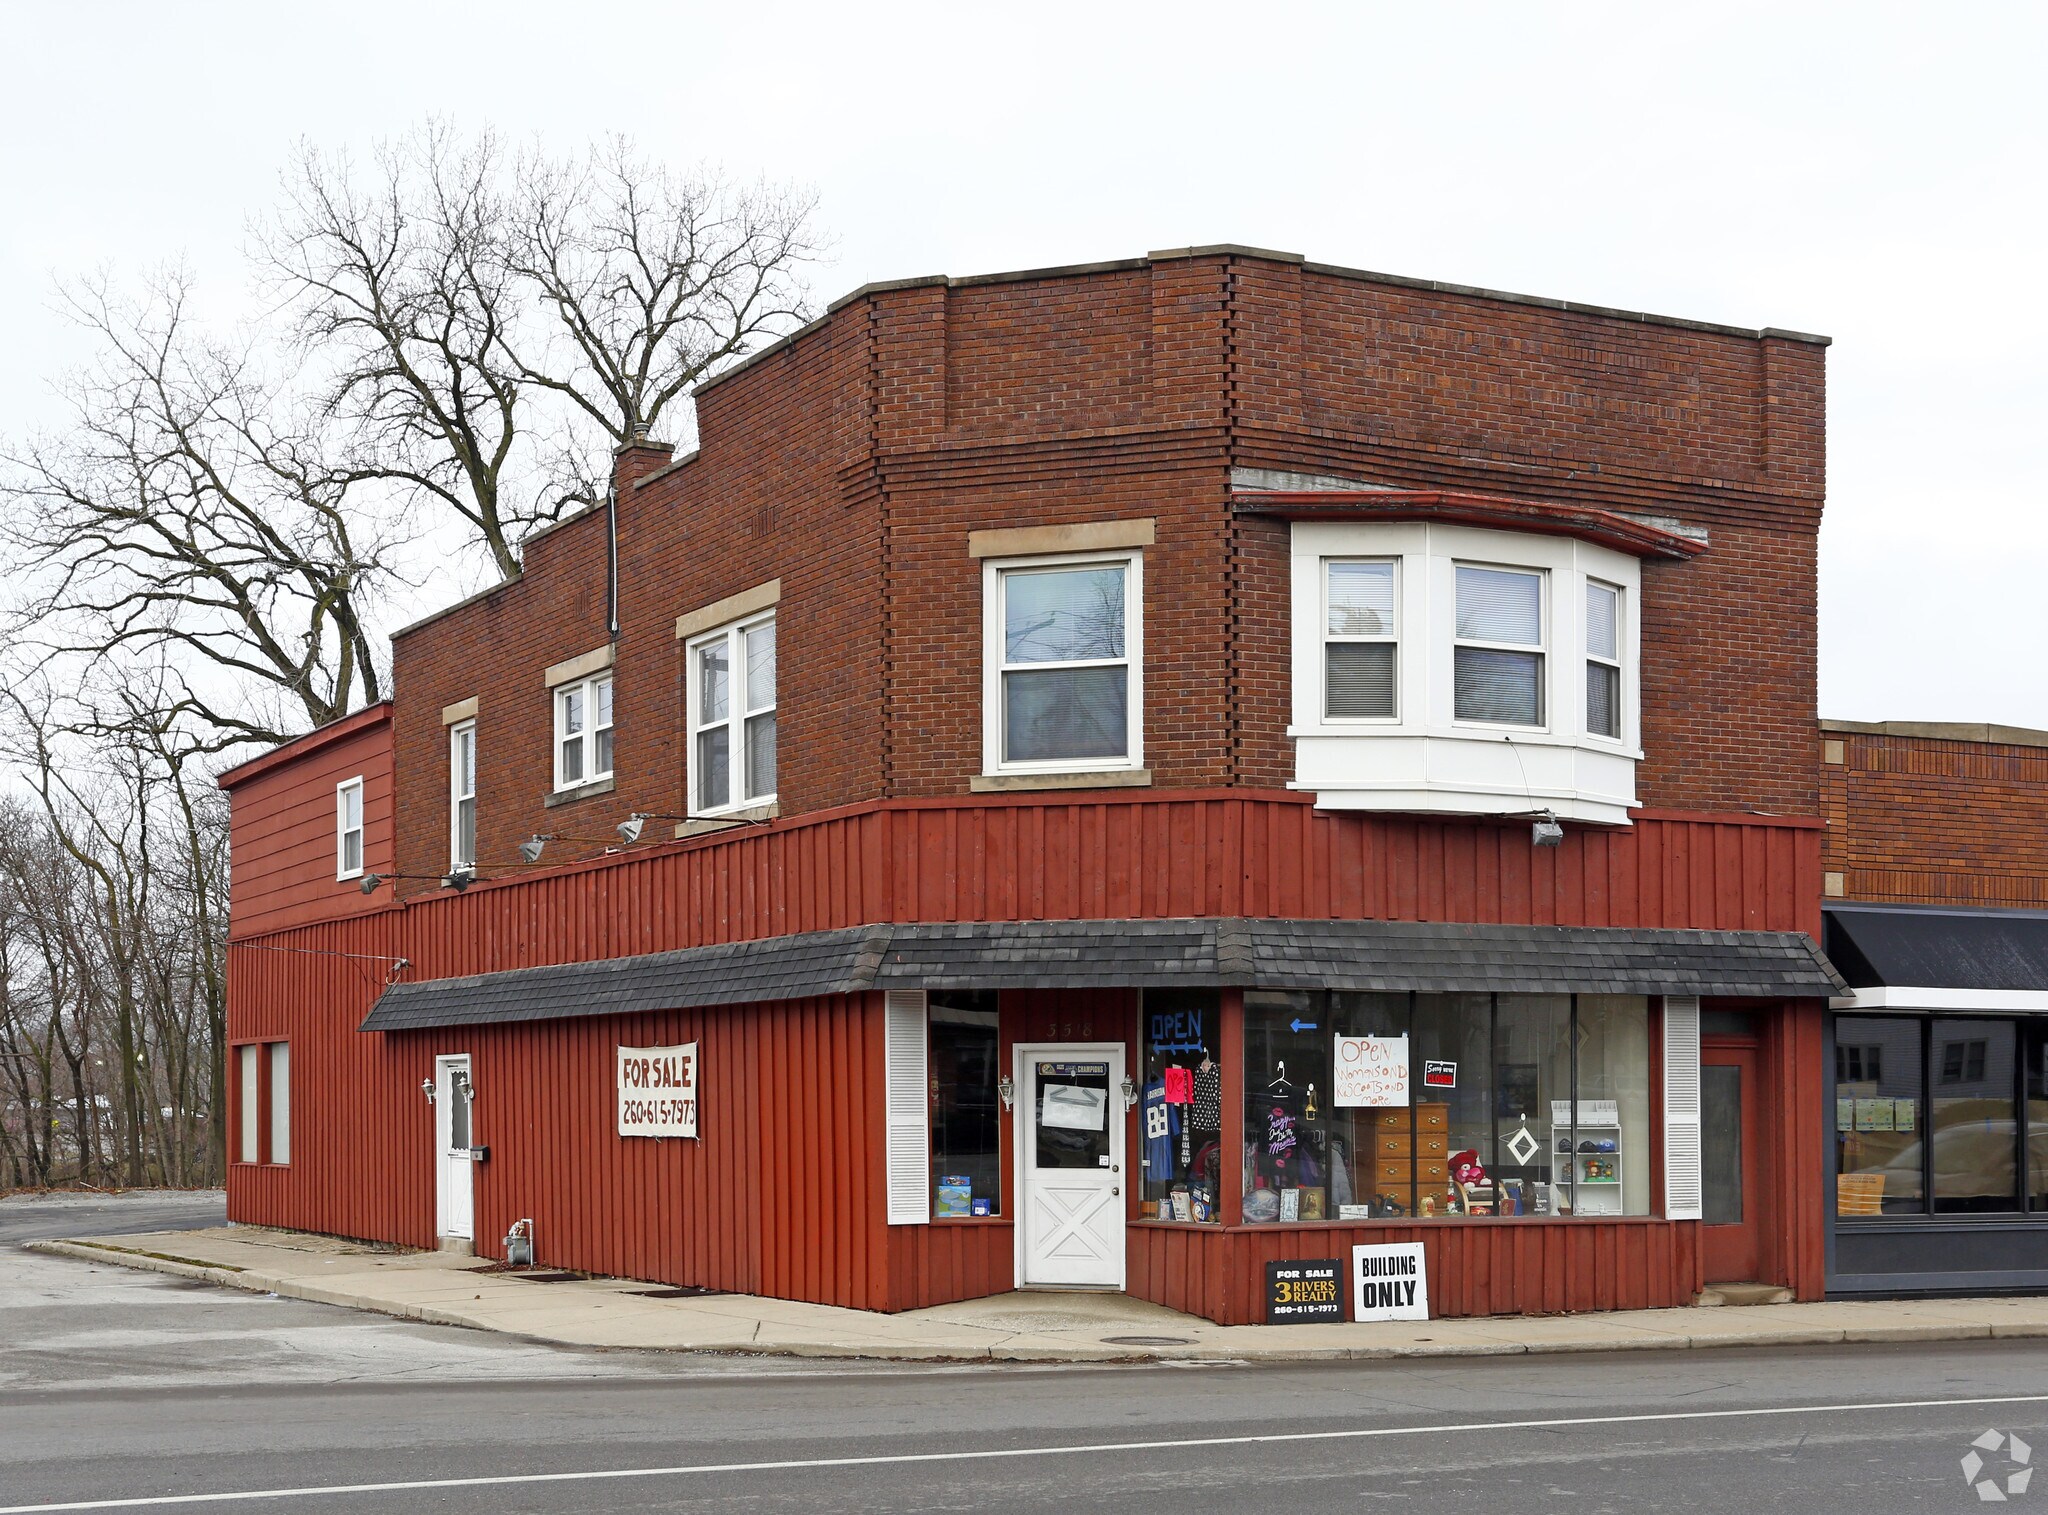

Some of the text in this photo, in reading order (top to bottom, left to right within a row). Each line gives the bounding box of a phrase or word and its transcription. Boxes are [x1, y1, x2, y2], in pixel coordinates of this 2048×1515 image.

[1152, 1009, 1202, 1040] OPEN
[623, 1055, 691, 1088] FOR SALE
[1077, 1065, 1103, 1073] CHAMPIONS
[1427, 1064, 1442, 1074] Sorry
[1427, 1073, 1453, 1085] CLOSED
[1362, 1255, 1416, 1277] BUILDING
[1277, 1269, 1334, 1279] FOR SALE
[1274, 1280, 1336, 1303] 3 RIVERS
[1293, 1290, 1337, 1303] REALTY
[1363, 1280, 1417, 1309] ONLY
[1274, 1304, 1338, 1314] 260-615-7973
